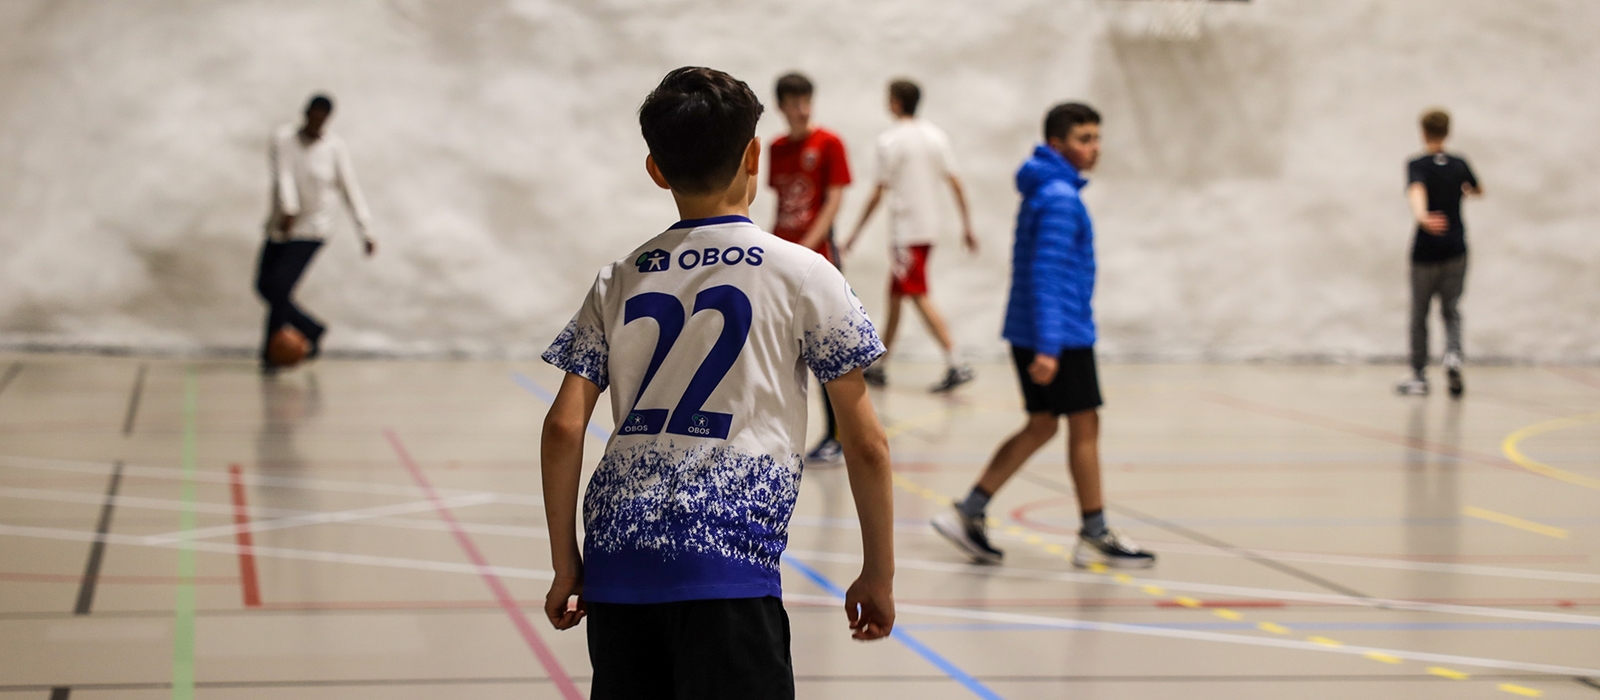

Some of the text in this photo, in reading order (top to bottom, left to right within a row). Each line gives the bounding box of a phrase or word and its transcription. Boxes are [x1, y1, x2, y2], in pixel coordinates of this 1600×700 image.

[678, 246, 764, 270] OBOS
[618, 284, 753, 440] 22
[624, 425, 649, 433] OBOS
[687, 426, 710, 435] OBOS
